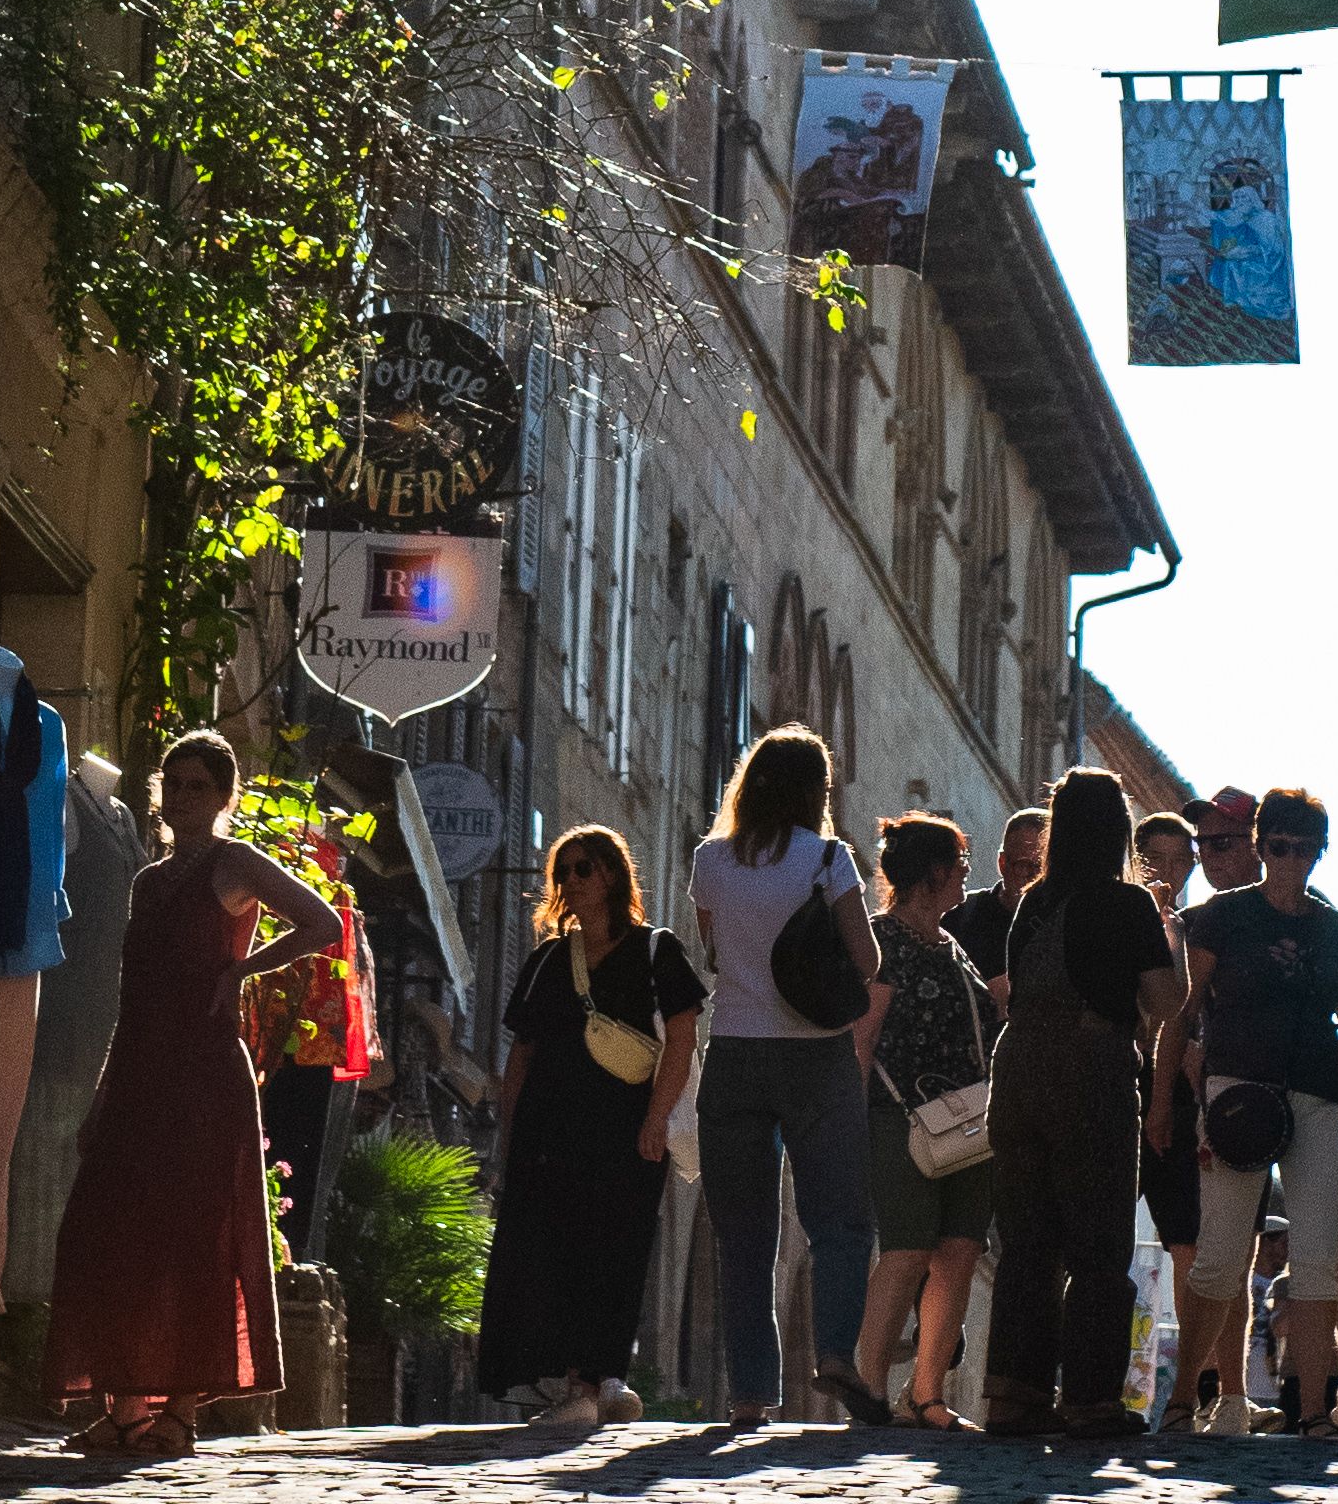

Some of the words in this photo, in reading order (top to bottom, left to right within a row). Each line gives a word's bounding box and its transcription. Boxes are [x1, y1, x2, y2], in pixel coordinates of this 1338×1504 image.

[363, 356, 488, 406] oyage
[306, 624, 470, 669] Raymond
[425, 810, 496, 835] ANTHE
